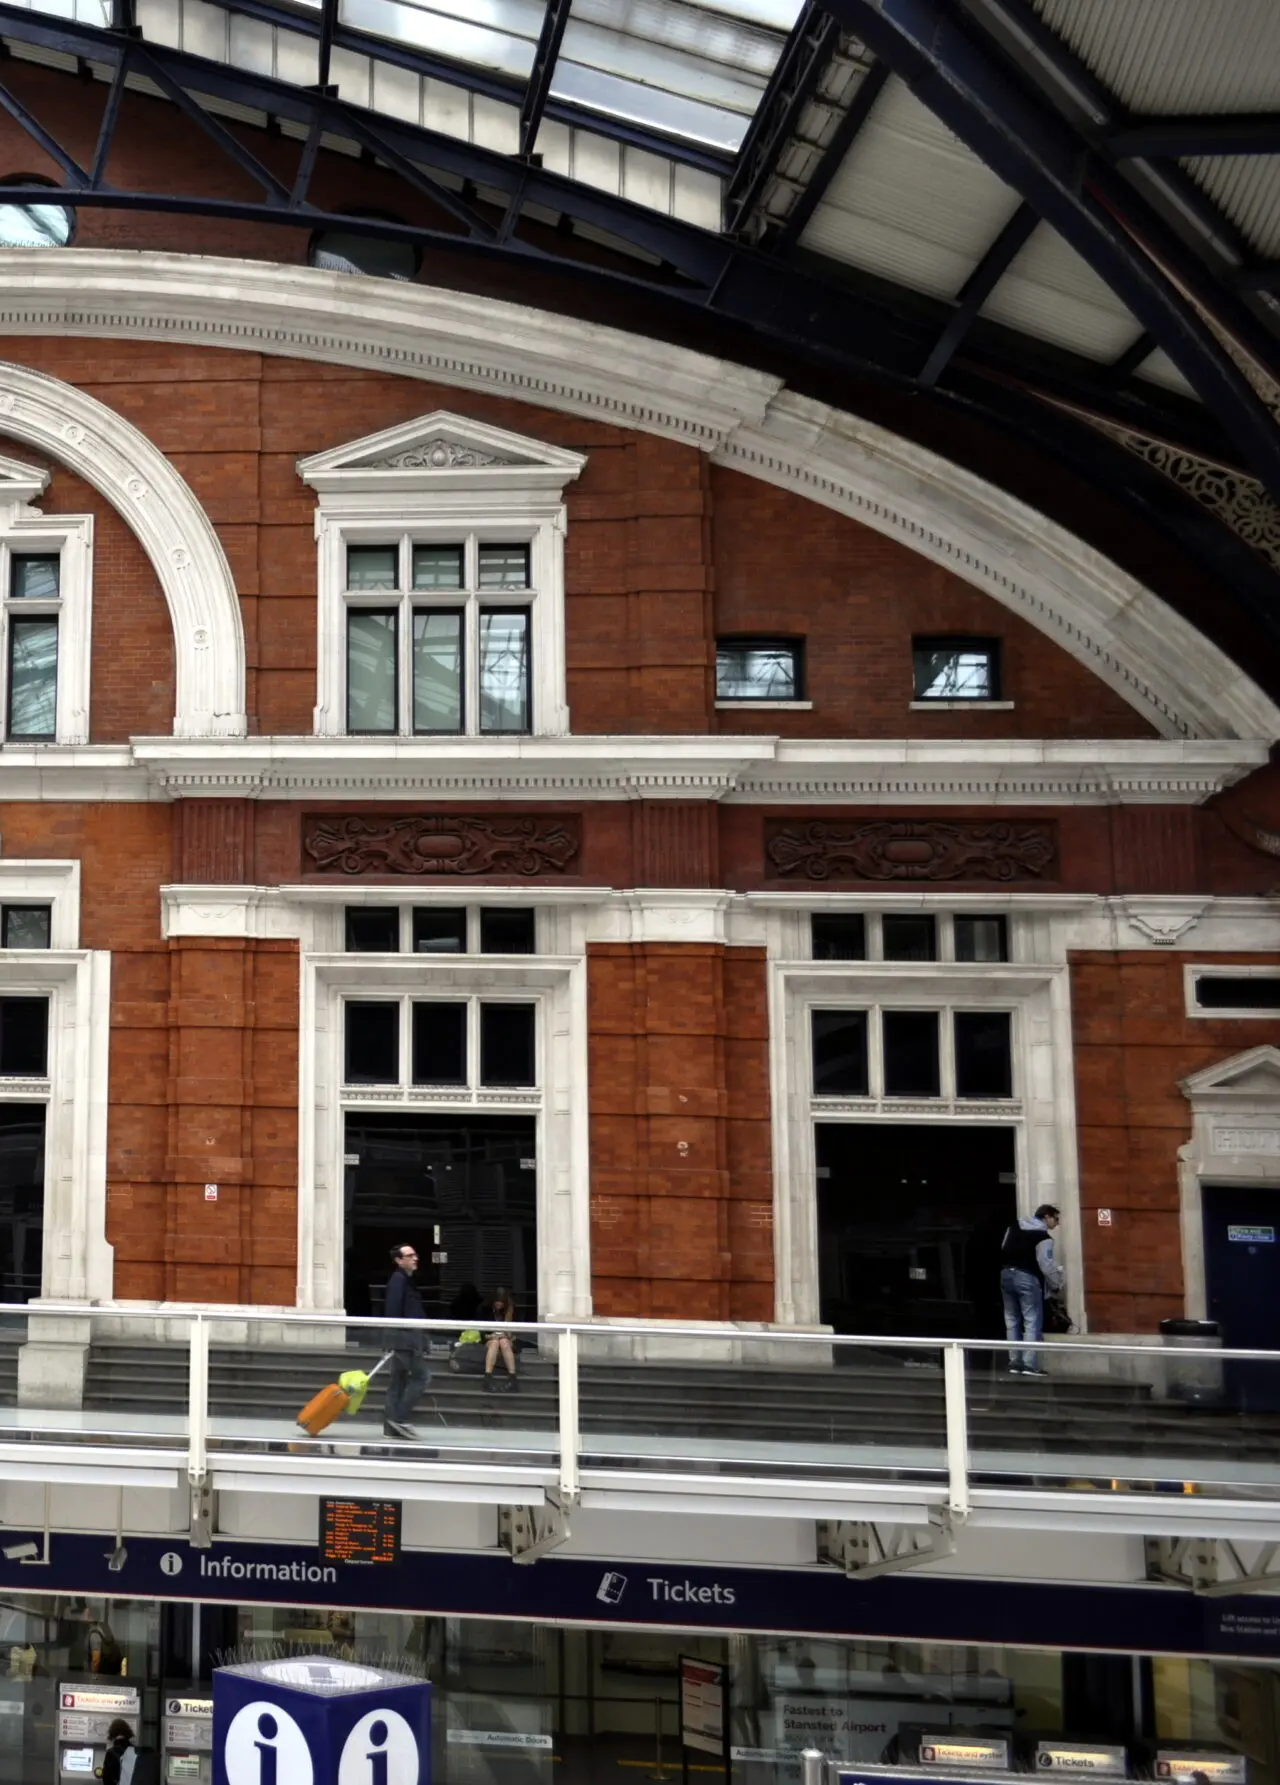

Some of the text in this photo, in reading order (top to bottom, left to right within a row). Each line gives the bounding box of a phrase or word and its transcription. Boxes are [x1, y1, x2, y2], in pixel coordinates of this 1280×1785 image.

[200, 1554, 337, 1583] Information
[647, 1578, 736, 1604] Tickets
[784, 1705, 844, 1717] Fastest to
[784, 1719, 887, 1734] Stansted Airport
[525, 1736, 548, 1745] Doors
[1056, 1756, 1095, 1768] Tickets
